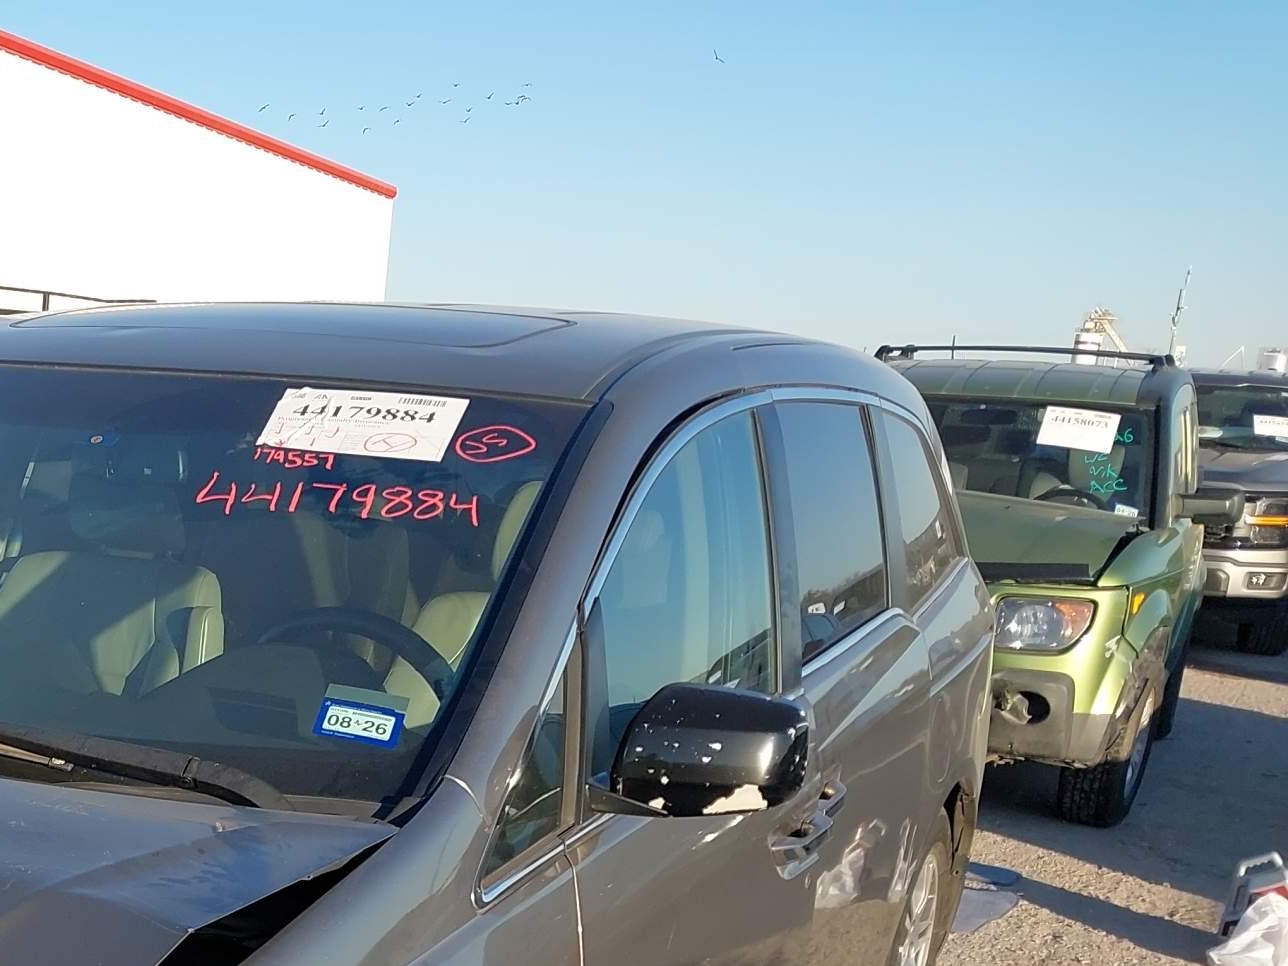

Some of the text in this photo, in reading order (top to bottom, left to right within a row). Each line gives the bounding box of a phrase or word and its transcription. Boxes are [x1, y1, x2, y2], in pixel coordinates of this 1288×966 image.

[292, 404, 437, 424] 44179884
[195, 471, 480, 527] 44179884
[327, 714, 352, 729] 08
[362, 720, 388, 736] 26
